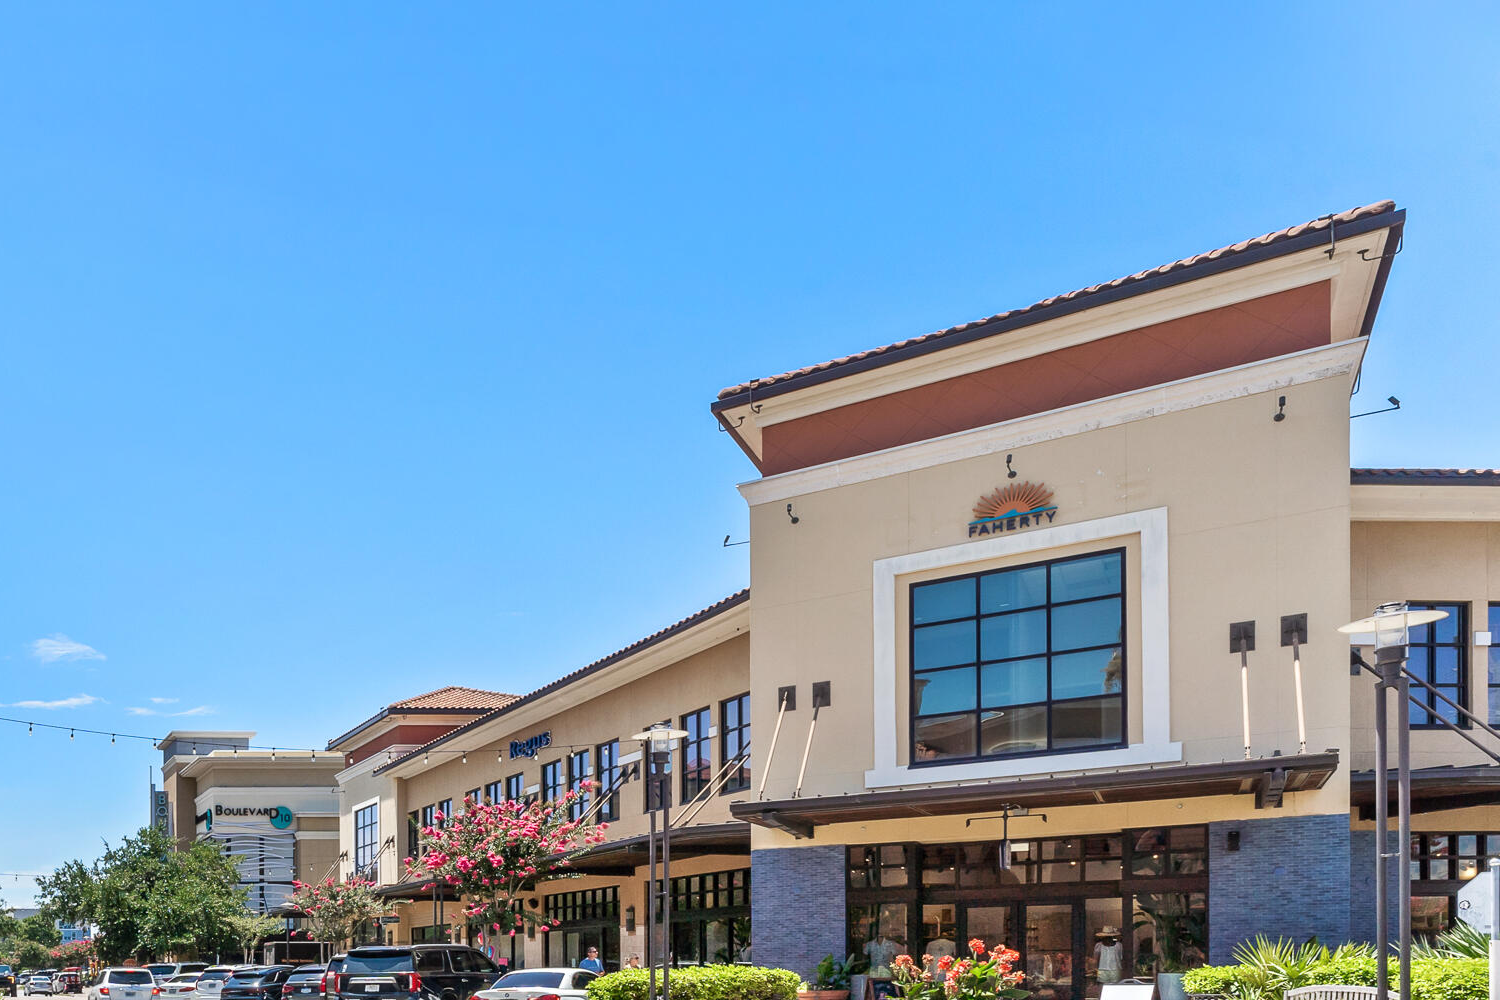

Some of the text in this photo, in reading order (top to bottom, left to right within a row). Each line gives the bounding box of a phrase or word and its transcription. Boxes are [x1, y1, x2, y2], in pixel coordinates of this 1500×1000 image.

[968, 511, 1056, 538] FAHERTY
[509, 730, 551, 760] Regus
[215, 804, 279, 819] BOULEVARD
[280, 813, 291, 823] 10
